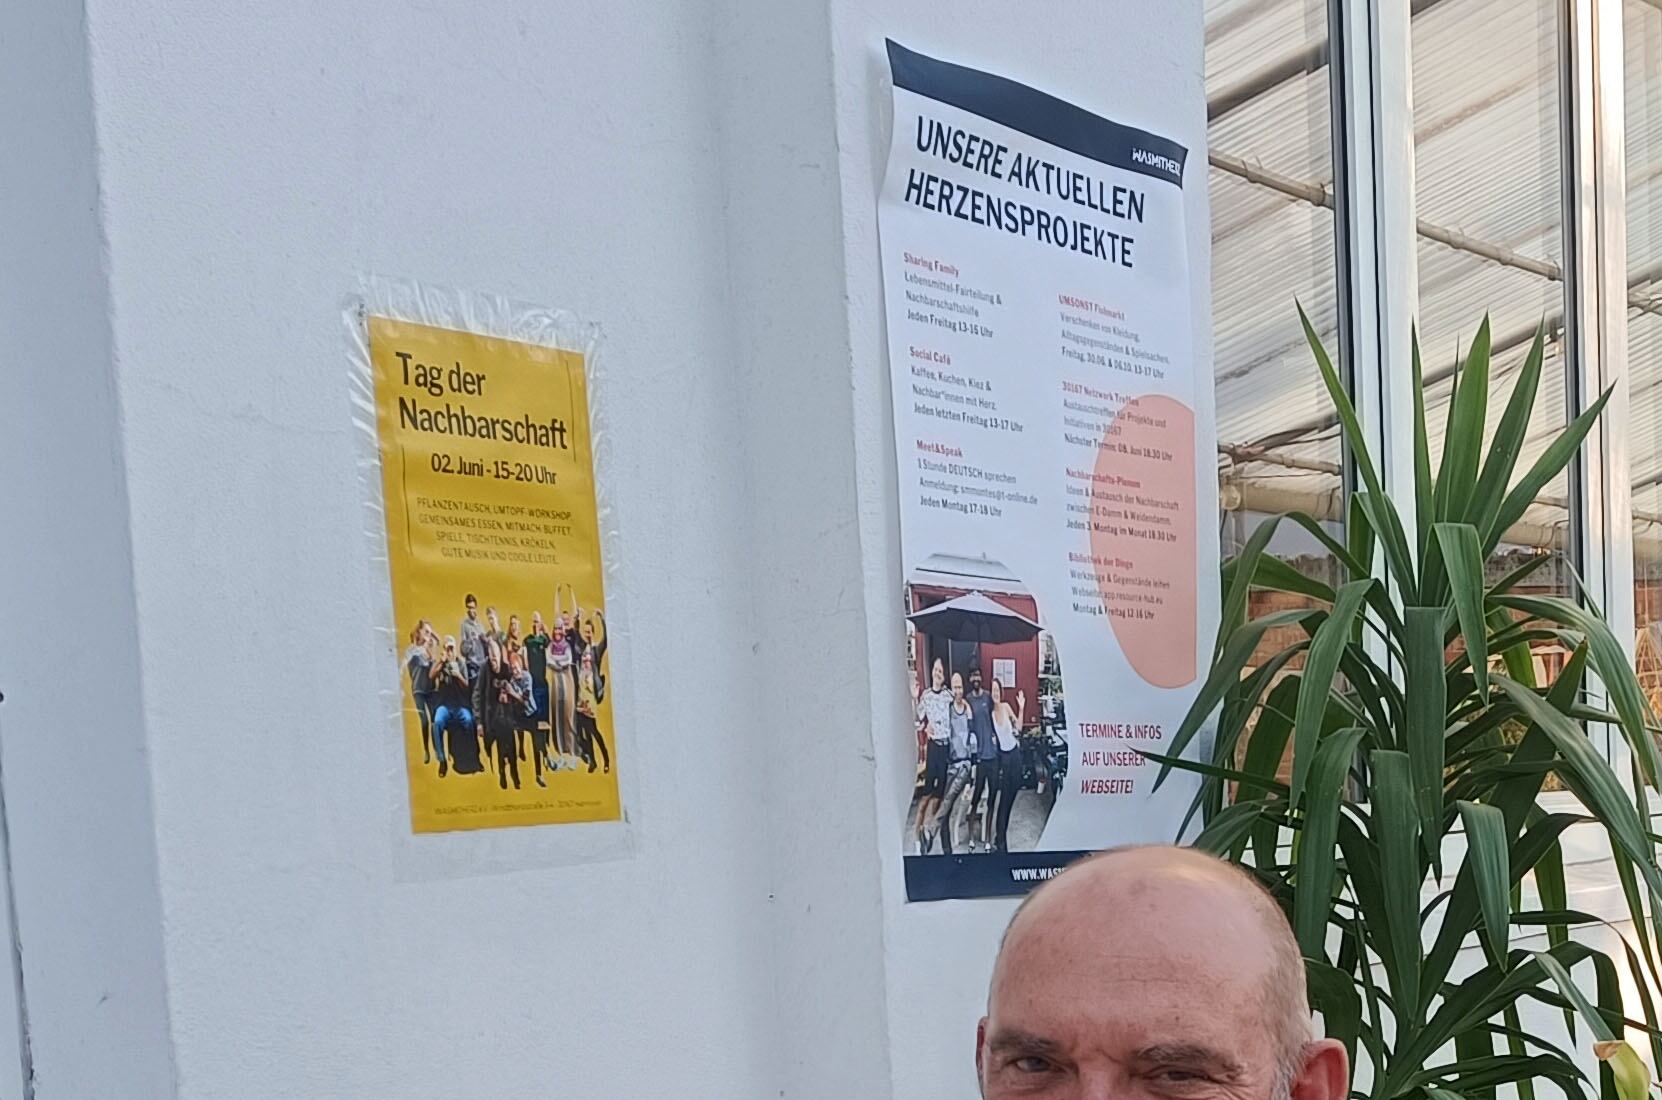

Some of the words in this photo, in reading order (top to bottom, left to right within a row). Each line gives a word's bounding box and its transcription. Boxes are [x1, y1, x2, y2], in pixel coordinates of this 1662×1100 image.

[916, 115, 1008, 179] UNSERE
[1008, 153, 1145, 223] AKTUELLEN
[905, 168, 1134, 268] HERZENSPROJEKTE
[904, 252, 933, 271] Sharing
[935, 261, 959, 278] Family
[906, 290, 979, 317] Nachbarschaftshilfe
[1059, 295, 1093, 312] UMSONST
[908, 308, 928, 323] Jeden
[930, 314, 956, 332] Freitag
[980, 326, 993, 337] Uhr
[910, 346, 932, 361] Social
[396, 352, 444, 396] Tag
[448, 362, 486, 395] der
[1153, 369, 1163, 379] Uhr
[986, 381, 991, 391] &
[966, 396, 977, 406] mit
[399, 397, 567, 449] Nachbarschaft
[915, 402, 933, 415] Jeden
[936, 407, 960, 421] letzten
[963, 412, 987, 428] Freitag
[1010, 422, 1023, 432] Uhr
[917, 440, 962, 457] Meet&Speak
[1162, 453, 1172, 461] Uhr
[457, 456, 483, 477] Juni
[494, 461, 533, 482] 15-20
[535, 466, 557, 484] Uhr
[949, 464, 982, 478] DEUTSCH
[921, 496, 939, 507] Jeden
[942, 498, 968, 514] Montag
[990, 506, 1002, 517] Uhr
[1066, 520, 1085, 529] Jeden
[1094, 523, 1117, 536] Montag
[1128, 528, 1147, 538] Monat
[1167, 532, 1176, 542] Uhr
[1073, 603, 1096, 615] Montag
[1144, 610, 1154, 619] Uhr
[1079, 723, 1123, 738] TERMINE
[1125, 726, 1133, 738] &
[1135, 726, 1161, 739] INFOS
[1082, 752, 1100, 766] AUF
[1081, 780, 1133, 794] WEBSEITE!
